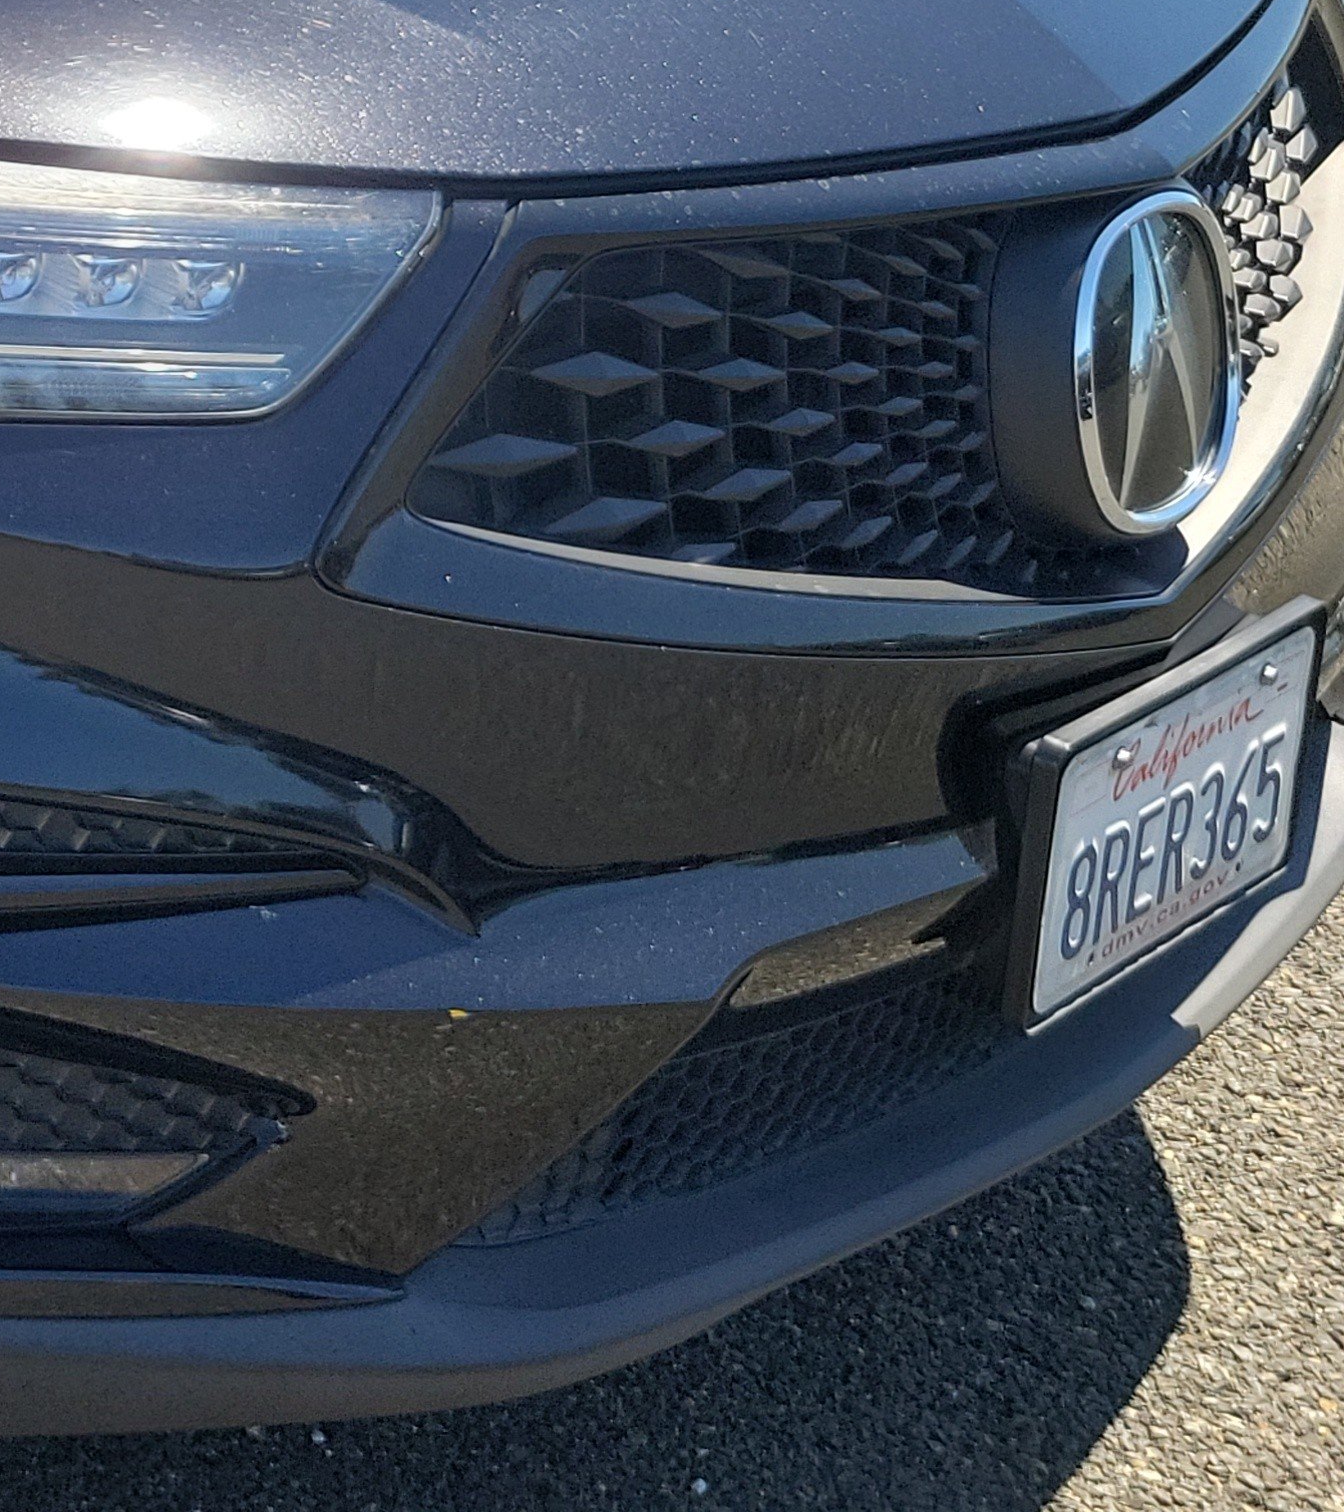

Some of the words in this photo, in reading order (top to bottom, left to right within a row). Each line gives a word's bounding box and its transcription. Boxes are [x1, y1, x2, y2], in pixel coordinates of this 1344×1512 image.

[1113, 697, 1264, 801] California
[1060, 723, 1287, 960] 8RER365
[1101, 870, 1230, 958] dmv.ca.gov
